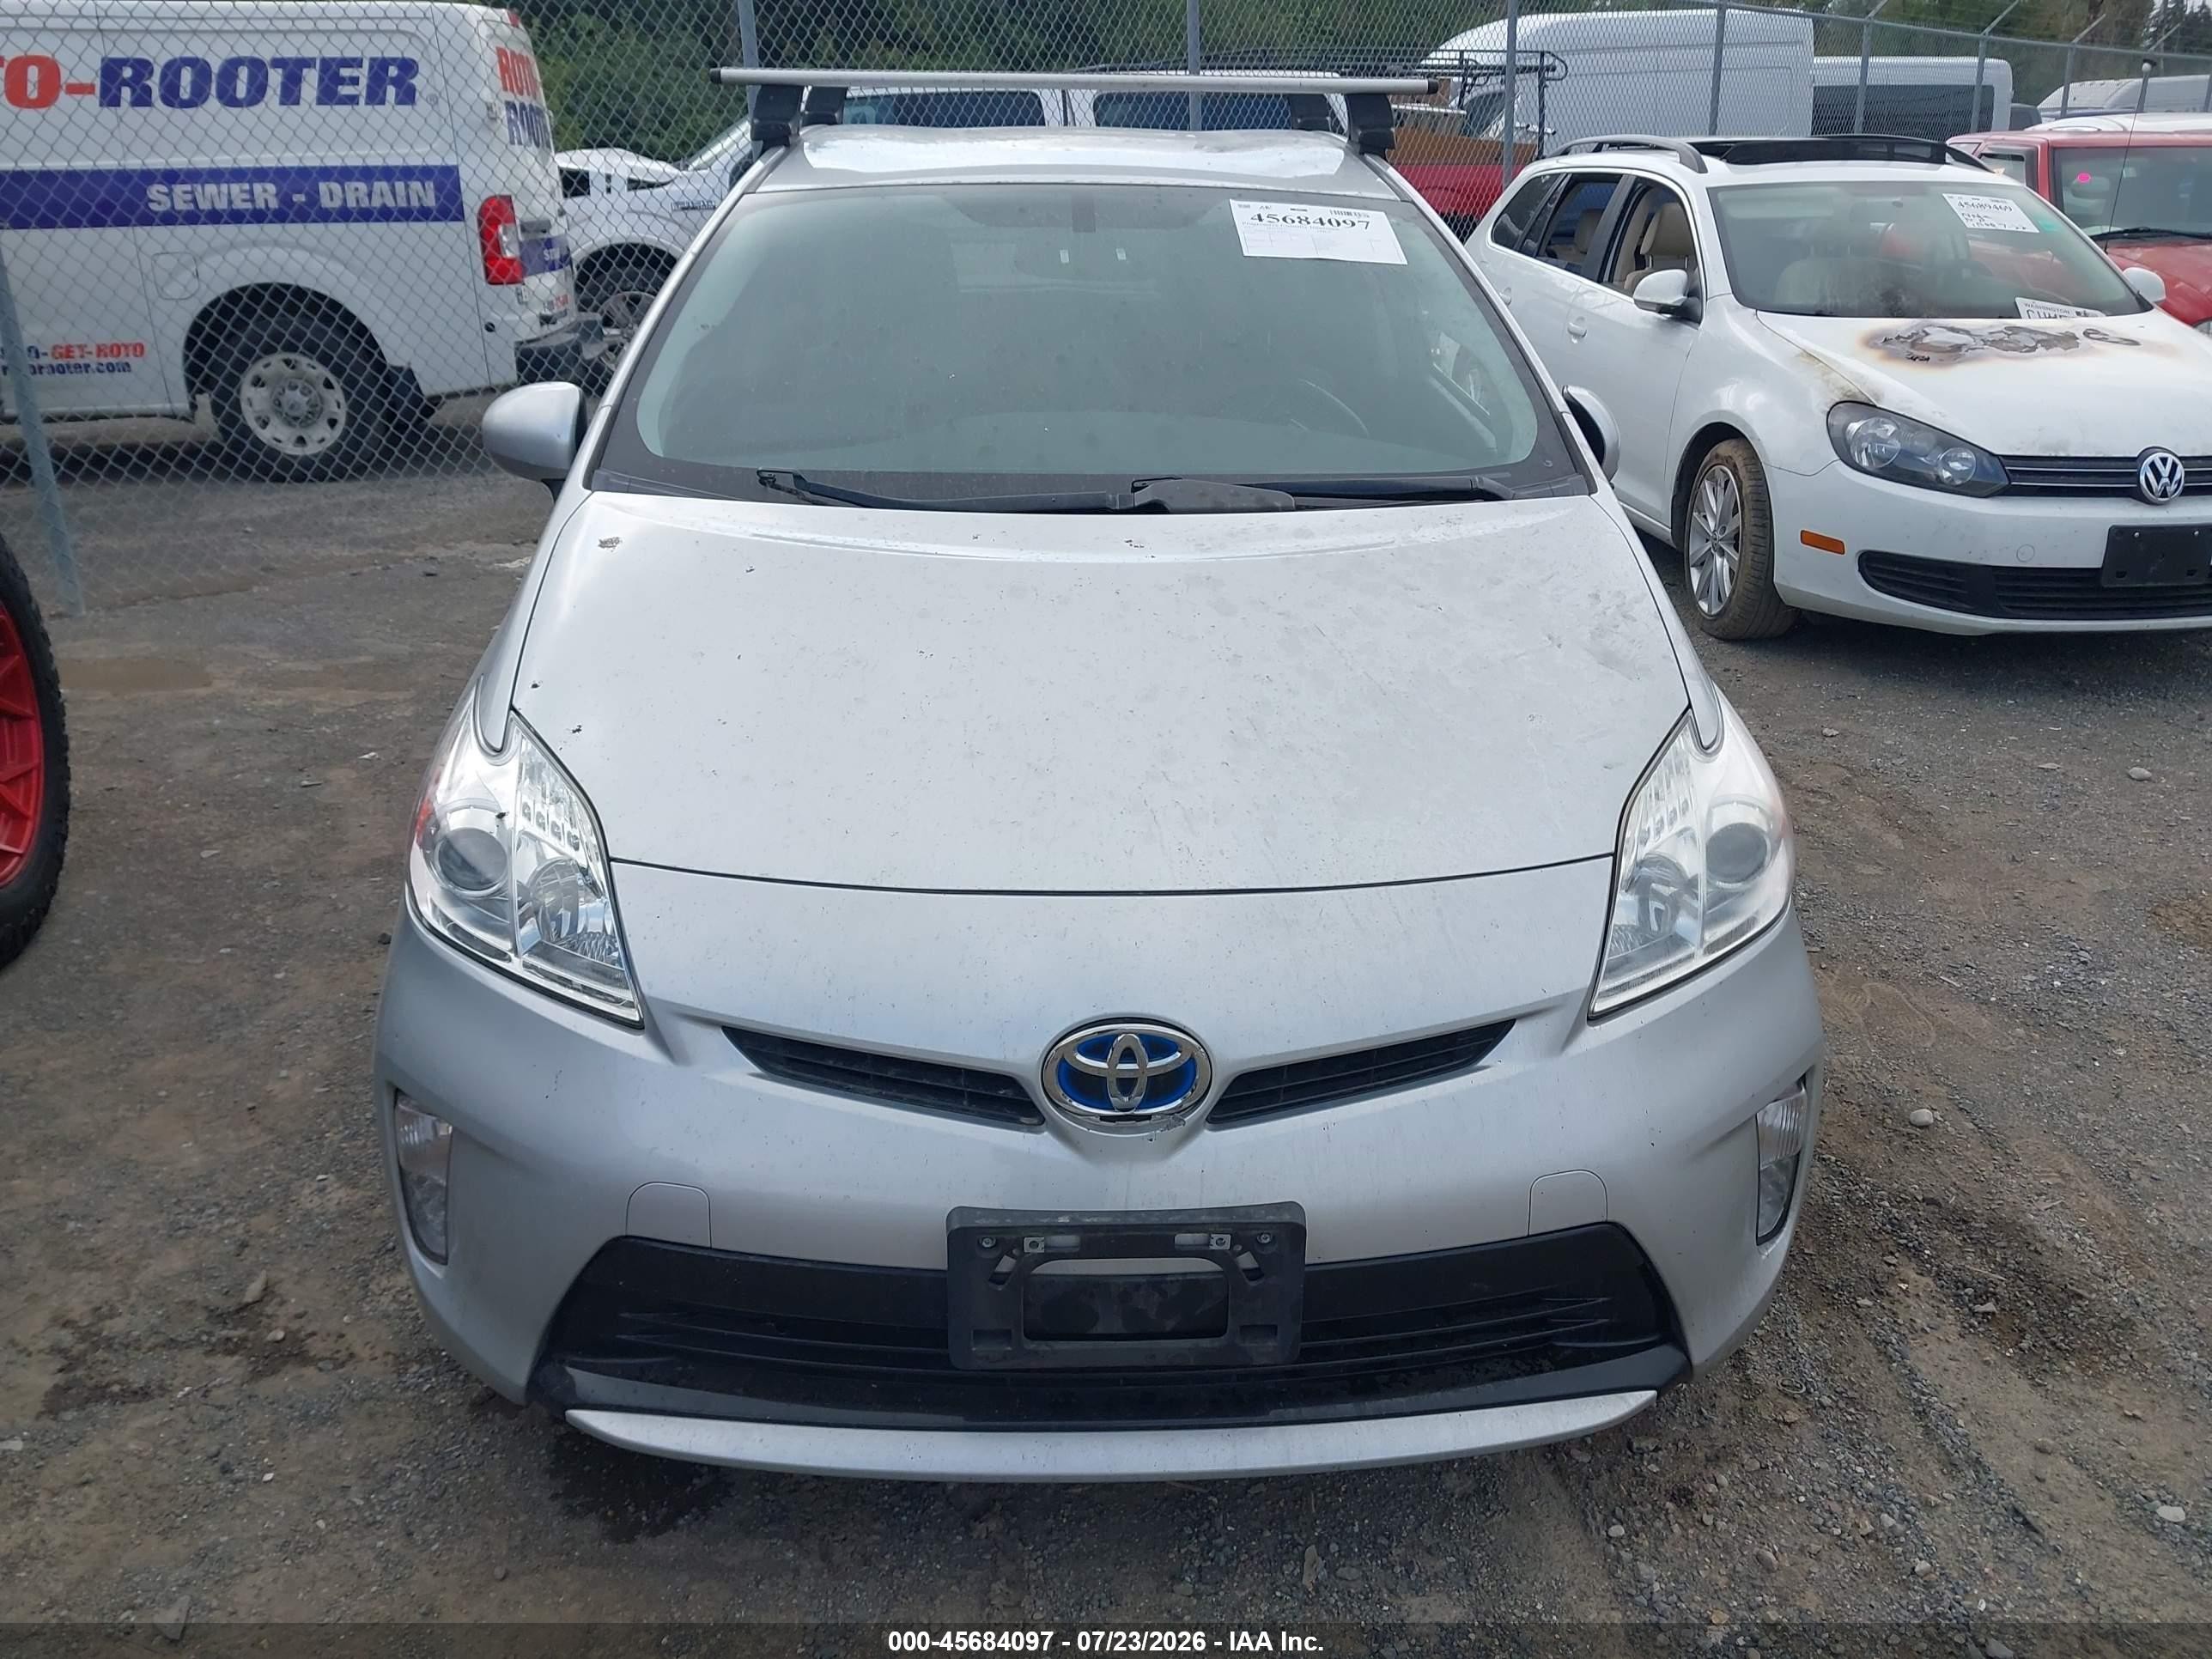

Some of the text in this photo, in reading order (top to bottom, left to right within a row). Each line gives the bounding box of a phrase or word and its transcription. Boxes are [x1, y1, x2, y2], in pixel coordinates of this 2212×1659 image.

[0, 54, 420, 110] O-ROOTER
[146, 182, 279, 211] SEWER
[318, 180, 436, 209] DRAIN
[1250, 212, 1370, 230] 45684097
